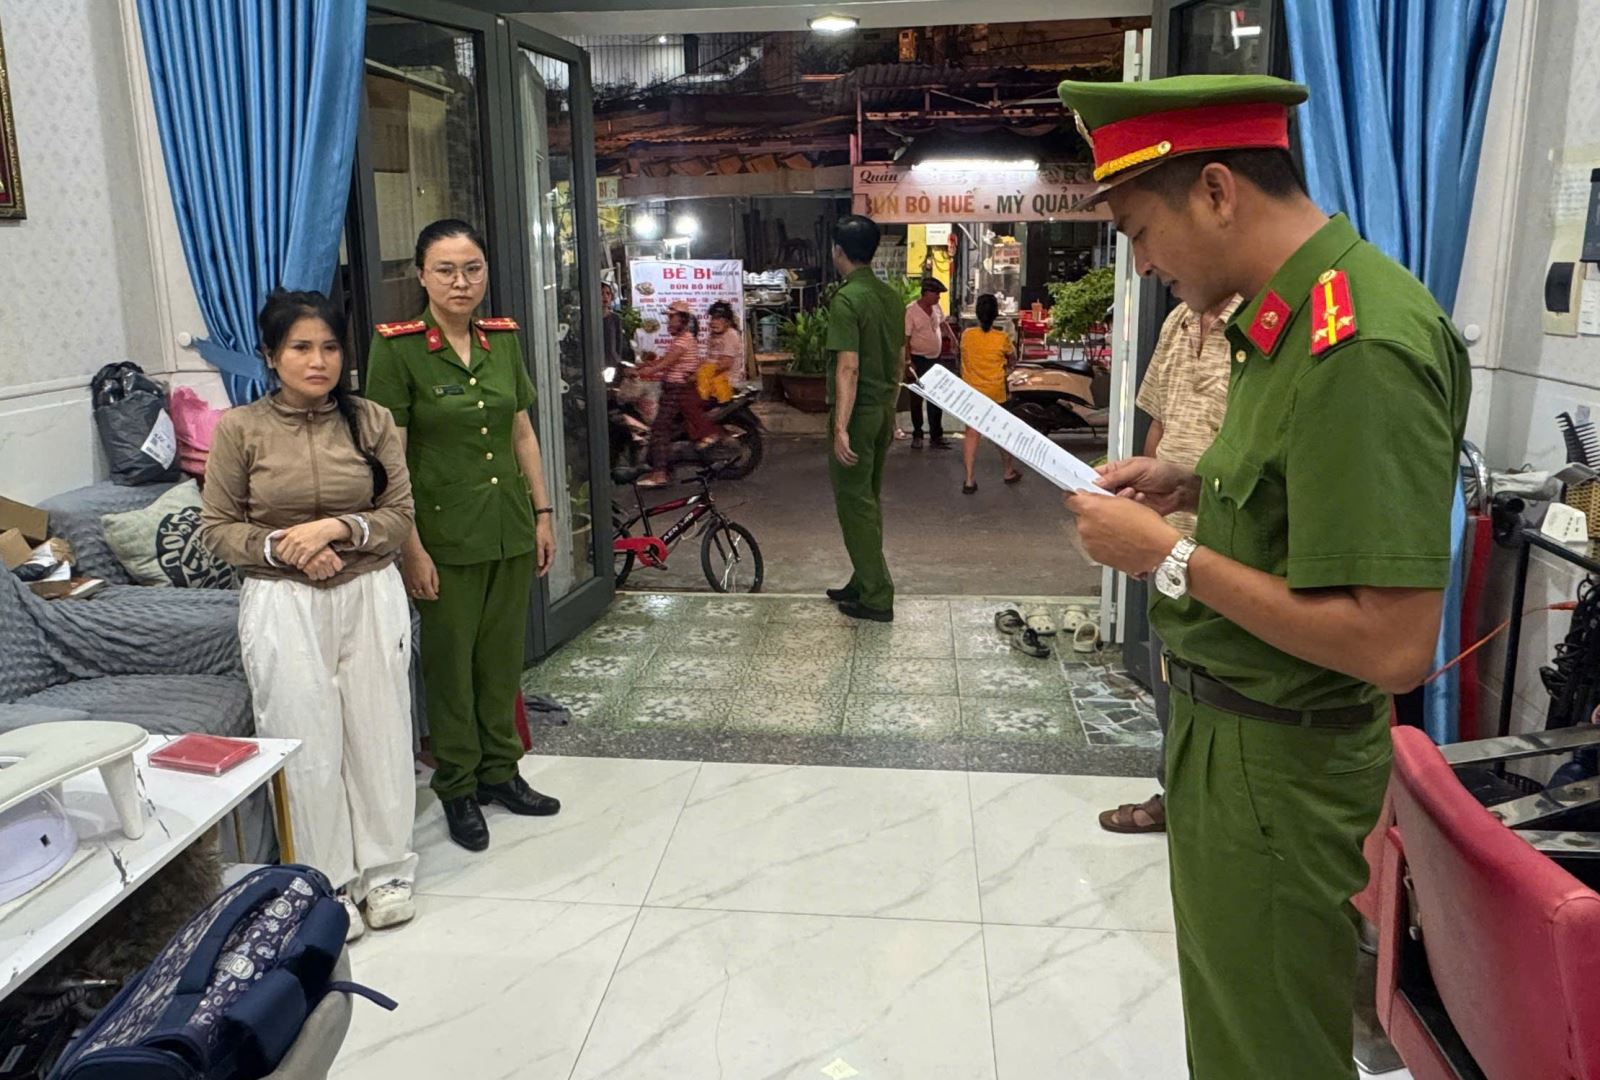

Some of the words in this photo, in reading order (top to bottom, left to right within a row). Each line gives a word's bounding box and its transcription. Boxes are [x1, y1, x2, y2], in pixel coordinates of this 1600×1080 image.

[906, 190, 930, 213] BÒ
[938, 187, 978, 213] HUẾ
[997, 189, 1025, 214] MỲ
